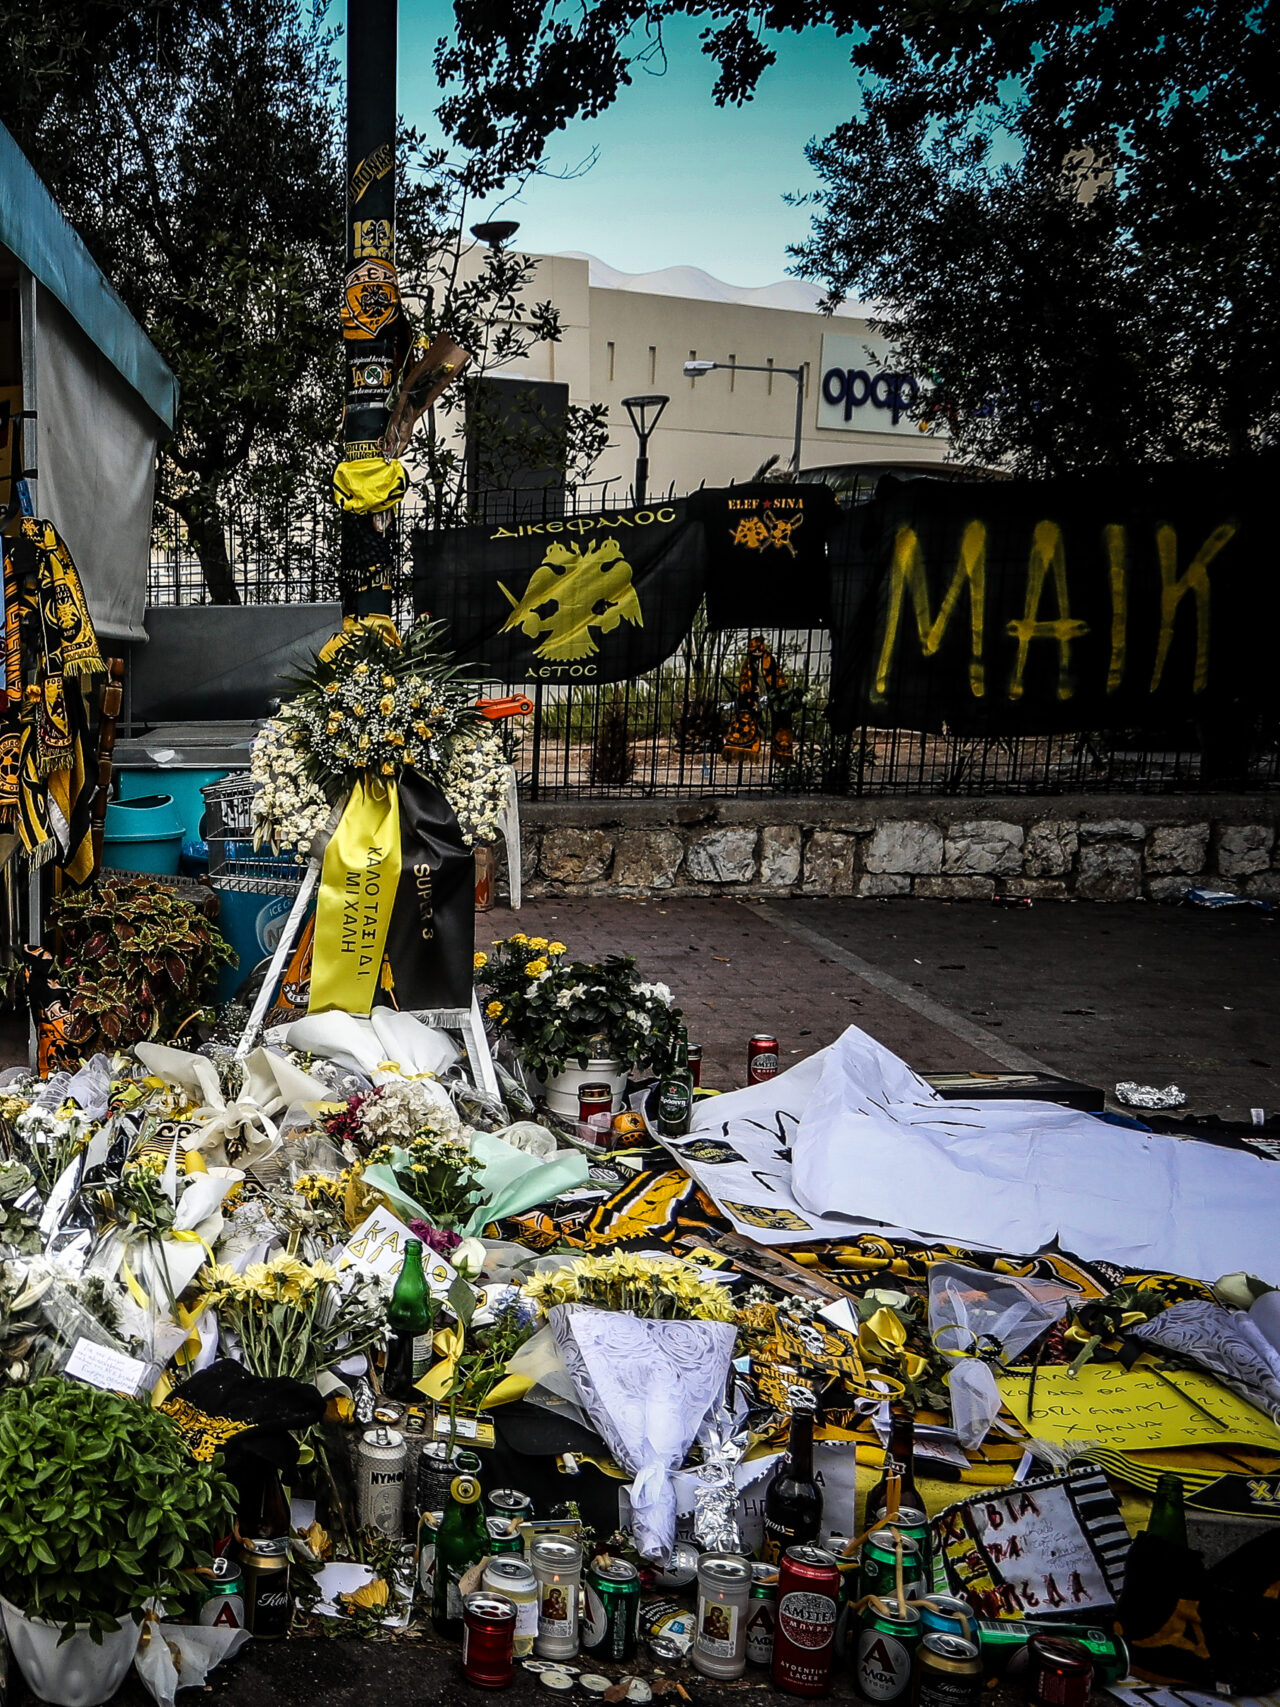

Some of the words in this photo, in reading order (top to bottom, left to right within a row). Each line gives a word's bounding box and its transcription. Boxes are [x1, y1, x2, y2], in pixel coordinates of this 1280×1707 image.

[728, 499, 761, 511] ELEF
[772, 498, 804, 510] SINA
[364, 846, 384, 896] ΚΑΛΟ
[269, 904, 284, 918] ICE
[421, 928, 434, 940] 3
[754, 1364, 815, 1391] ORIGINAL
